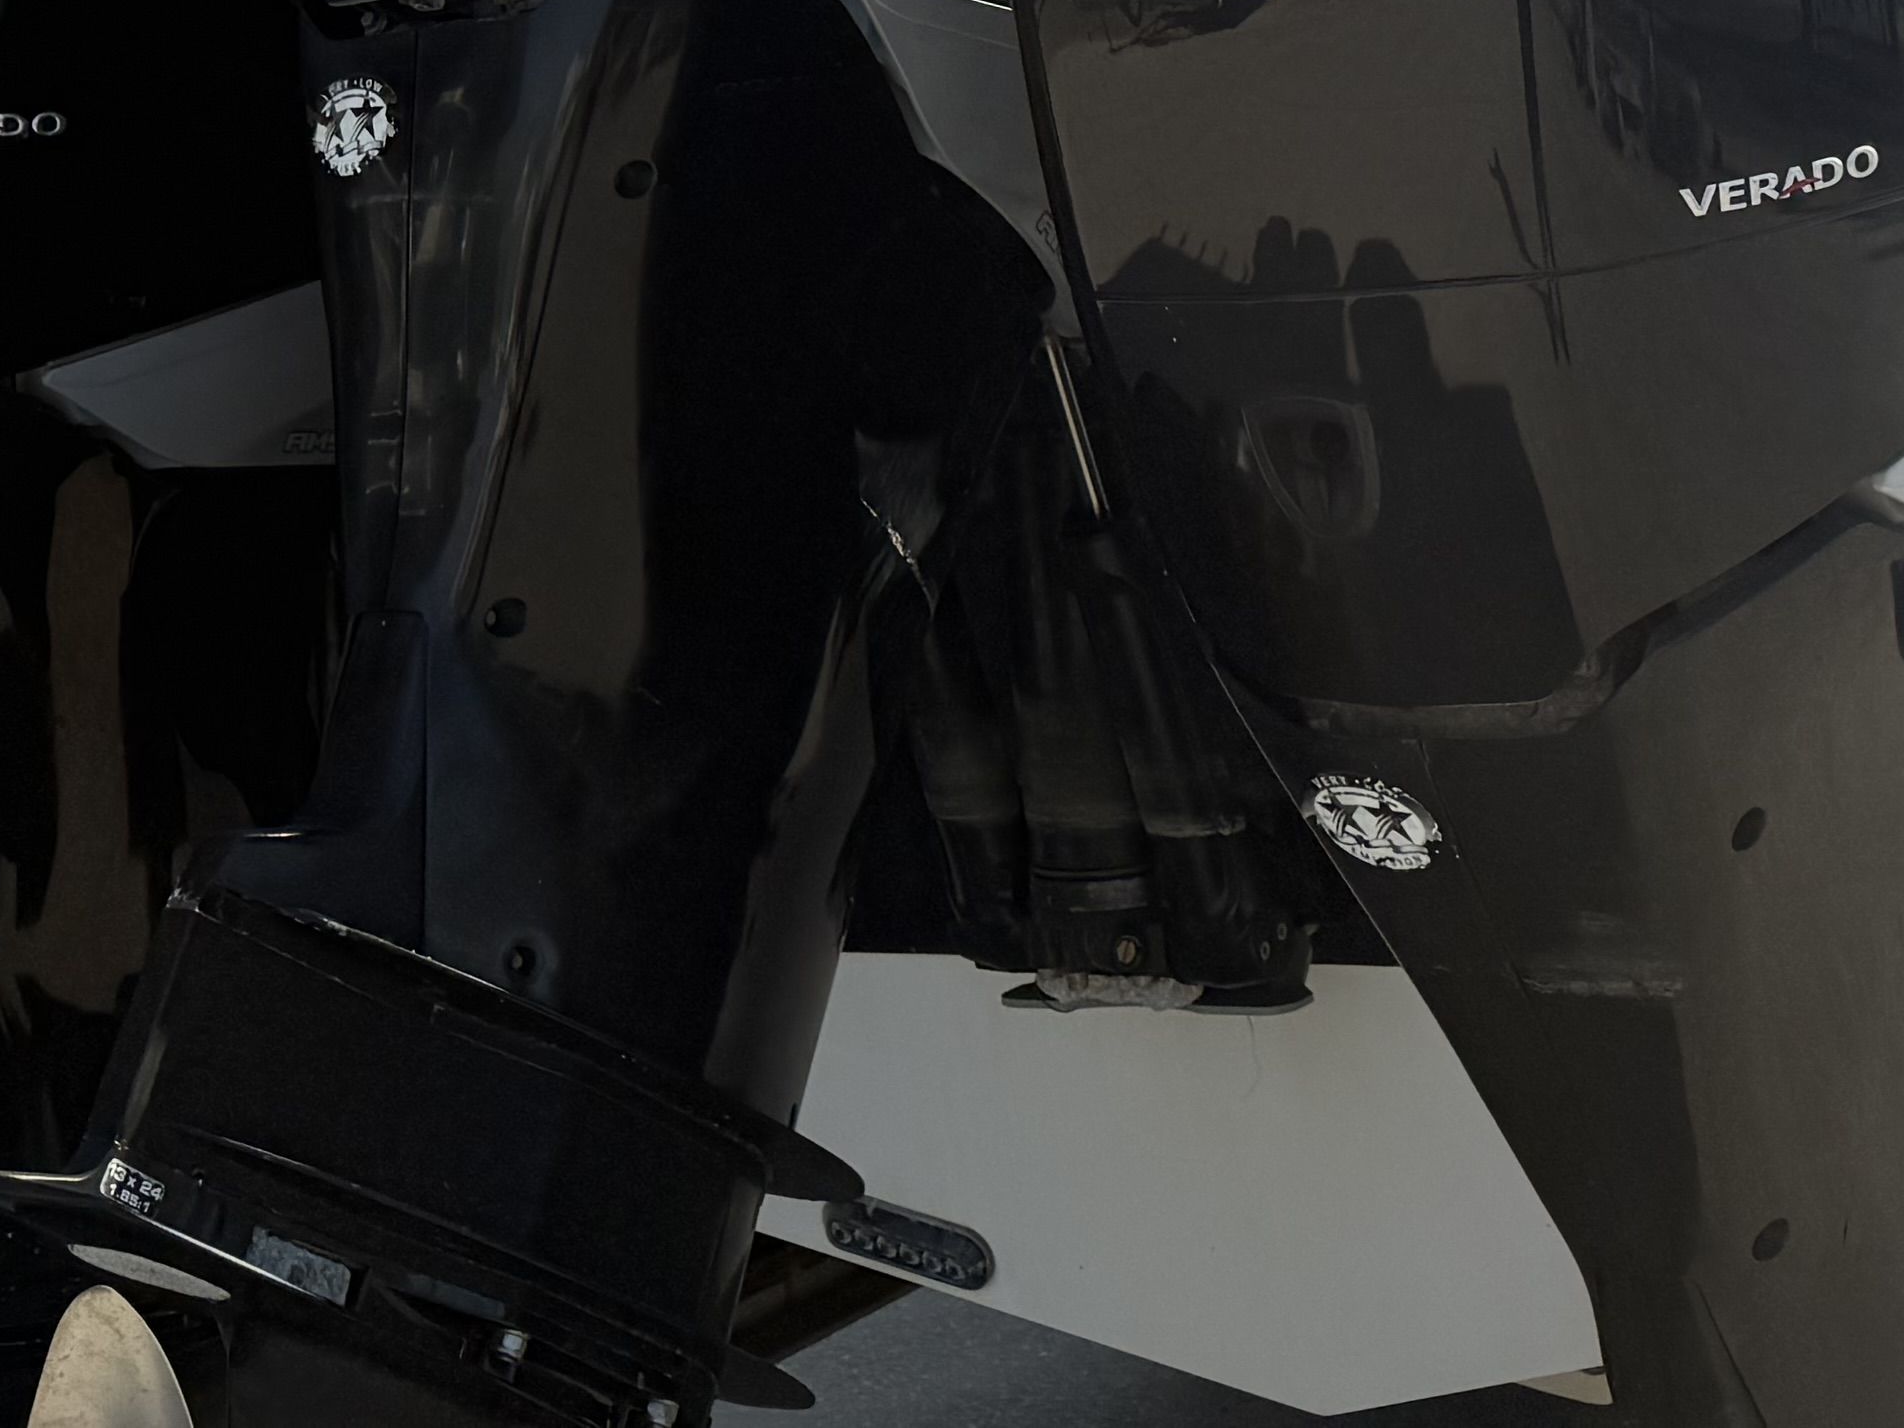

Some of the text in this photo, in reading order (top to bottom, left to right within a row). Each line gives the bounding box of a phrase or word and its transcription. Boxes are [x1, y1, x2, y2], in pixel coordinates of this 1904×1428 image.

[1679, 144, 1879, 217] VERADO
[109, 1163, 127, 1182] 13
[139, 1181, 162, 1201] 24
